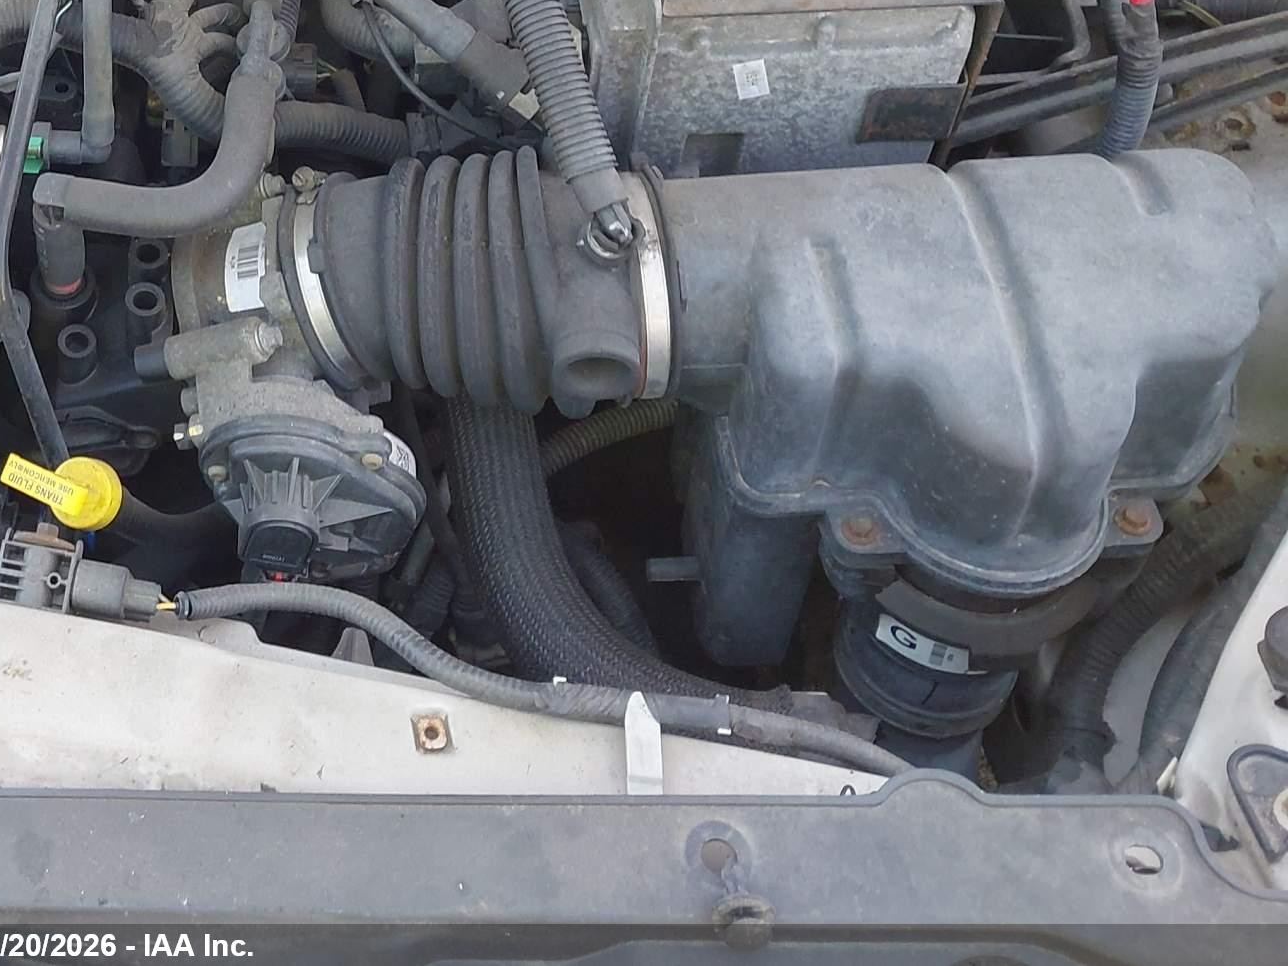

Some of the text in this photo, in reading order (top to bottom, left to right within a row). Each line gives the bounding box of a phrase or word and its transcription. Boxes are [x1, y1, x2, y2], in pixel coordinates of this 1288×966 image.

[8, 472, 64, 506] TRANS FLUID
[890, 624, 918, 650] G
